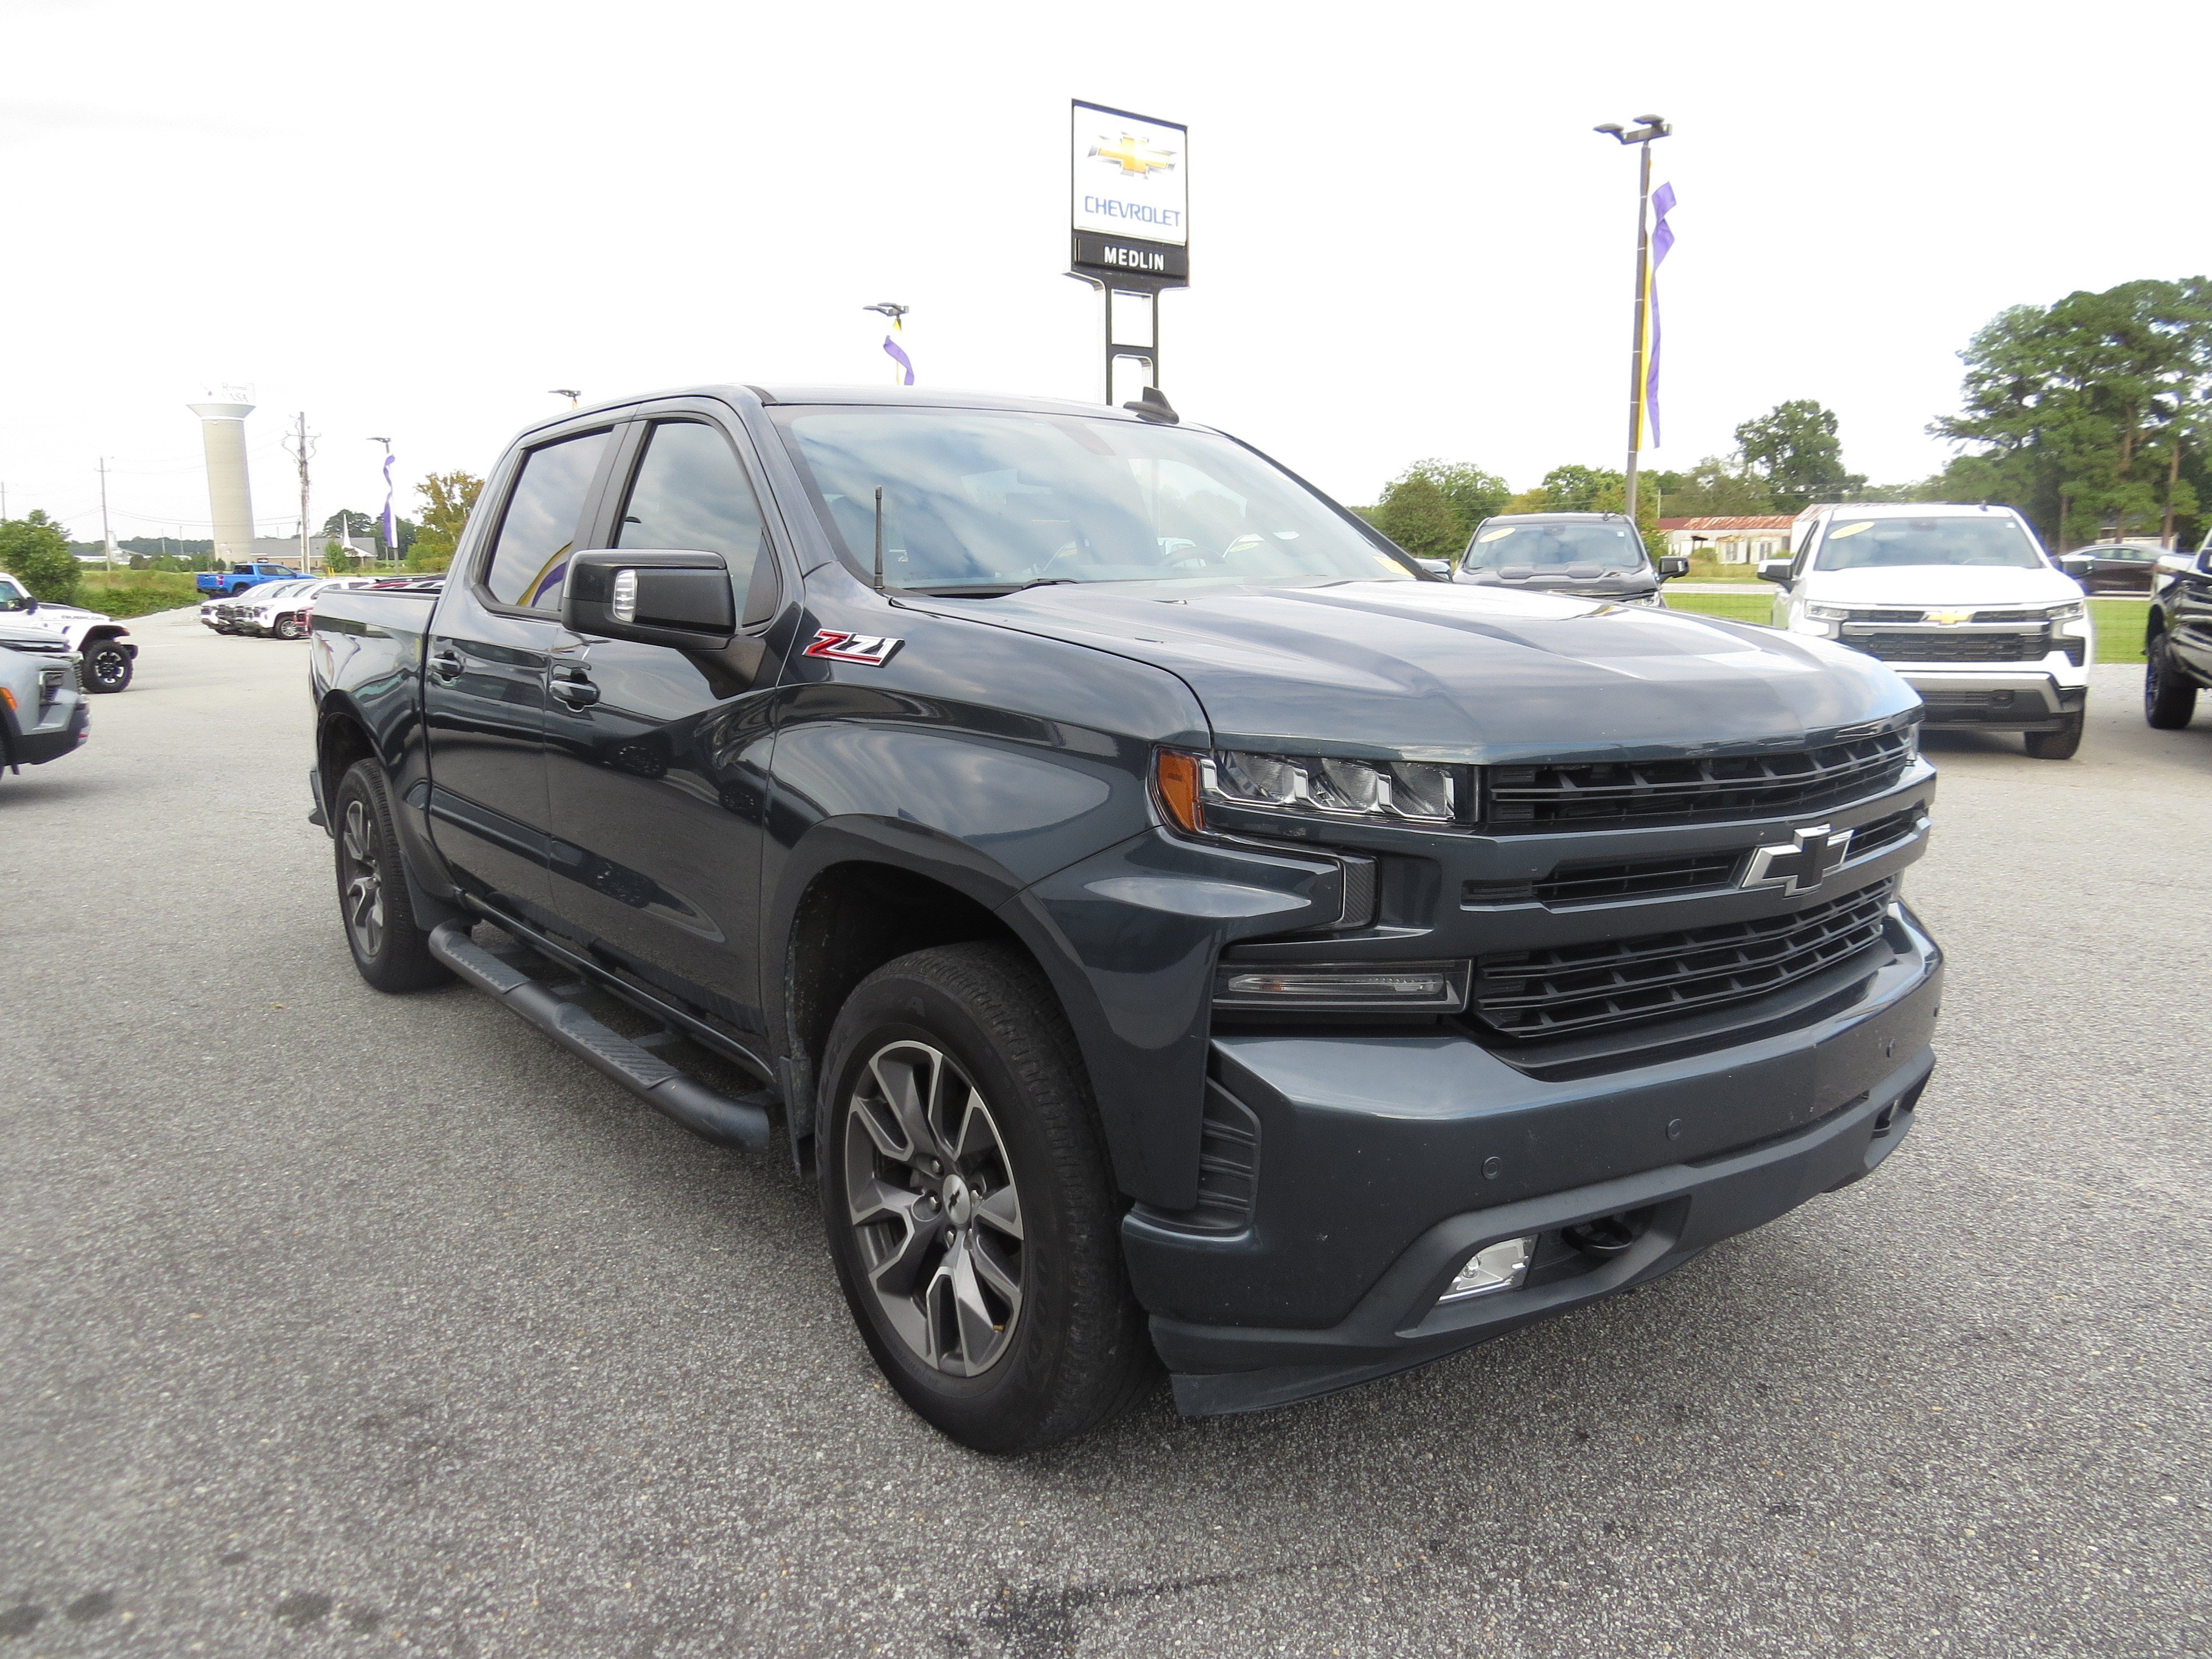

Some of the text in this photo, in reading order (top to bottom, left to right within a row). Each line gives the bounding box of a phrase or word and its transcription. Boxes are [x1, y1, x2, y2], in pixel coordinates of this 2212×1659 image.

[1084, 195, 1181, 227] CHEVROLET
[1104, 246, 1165, 270] MEDLIN
[802, 628, 905, 667] Z71
